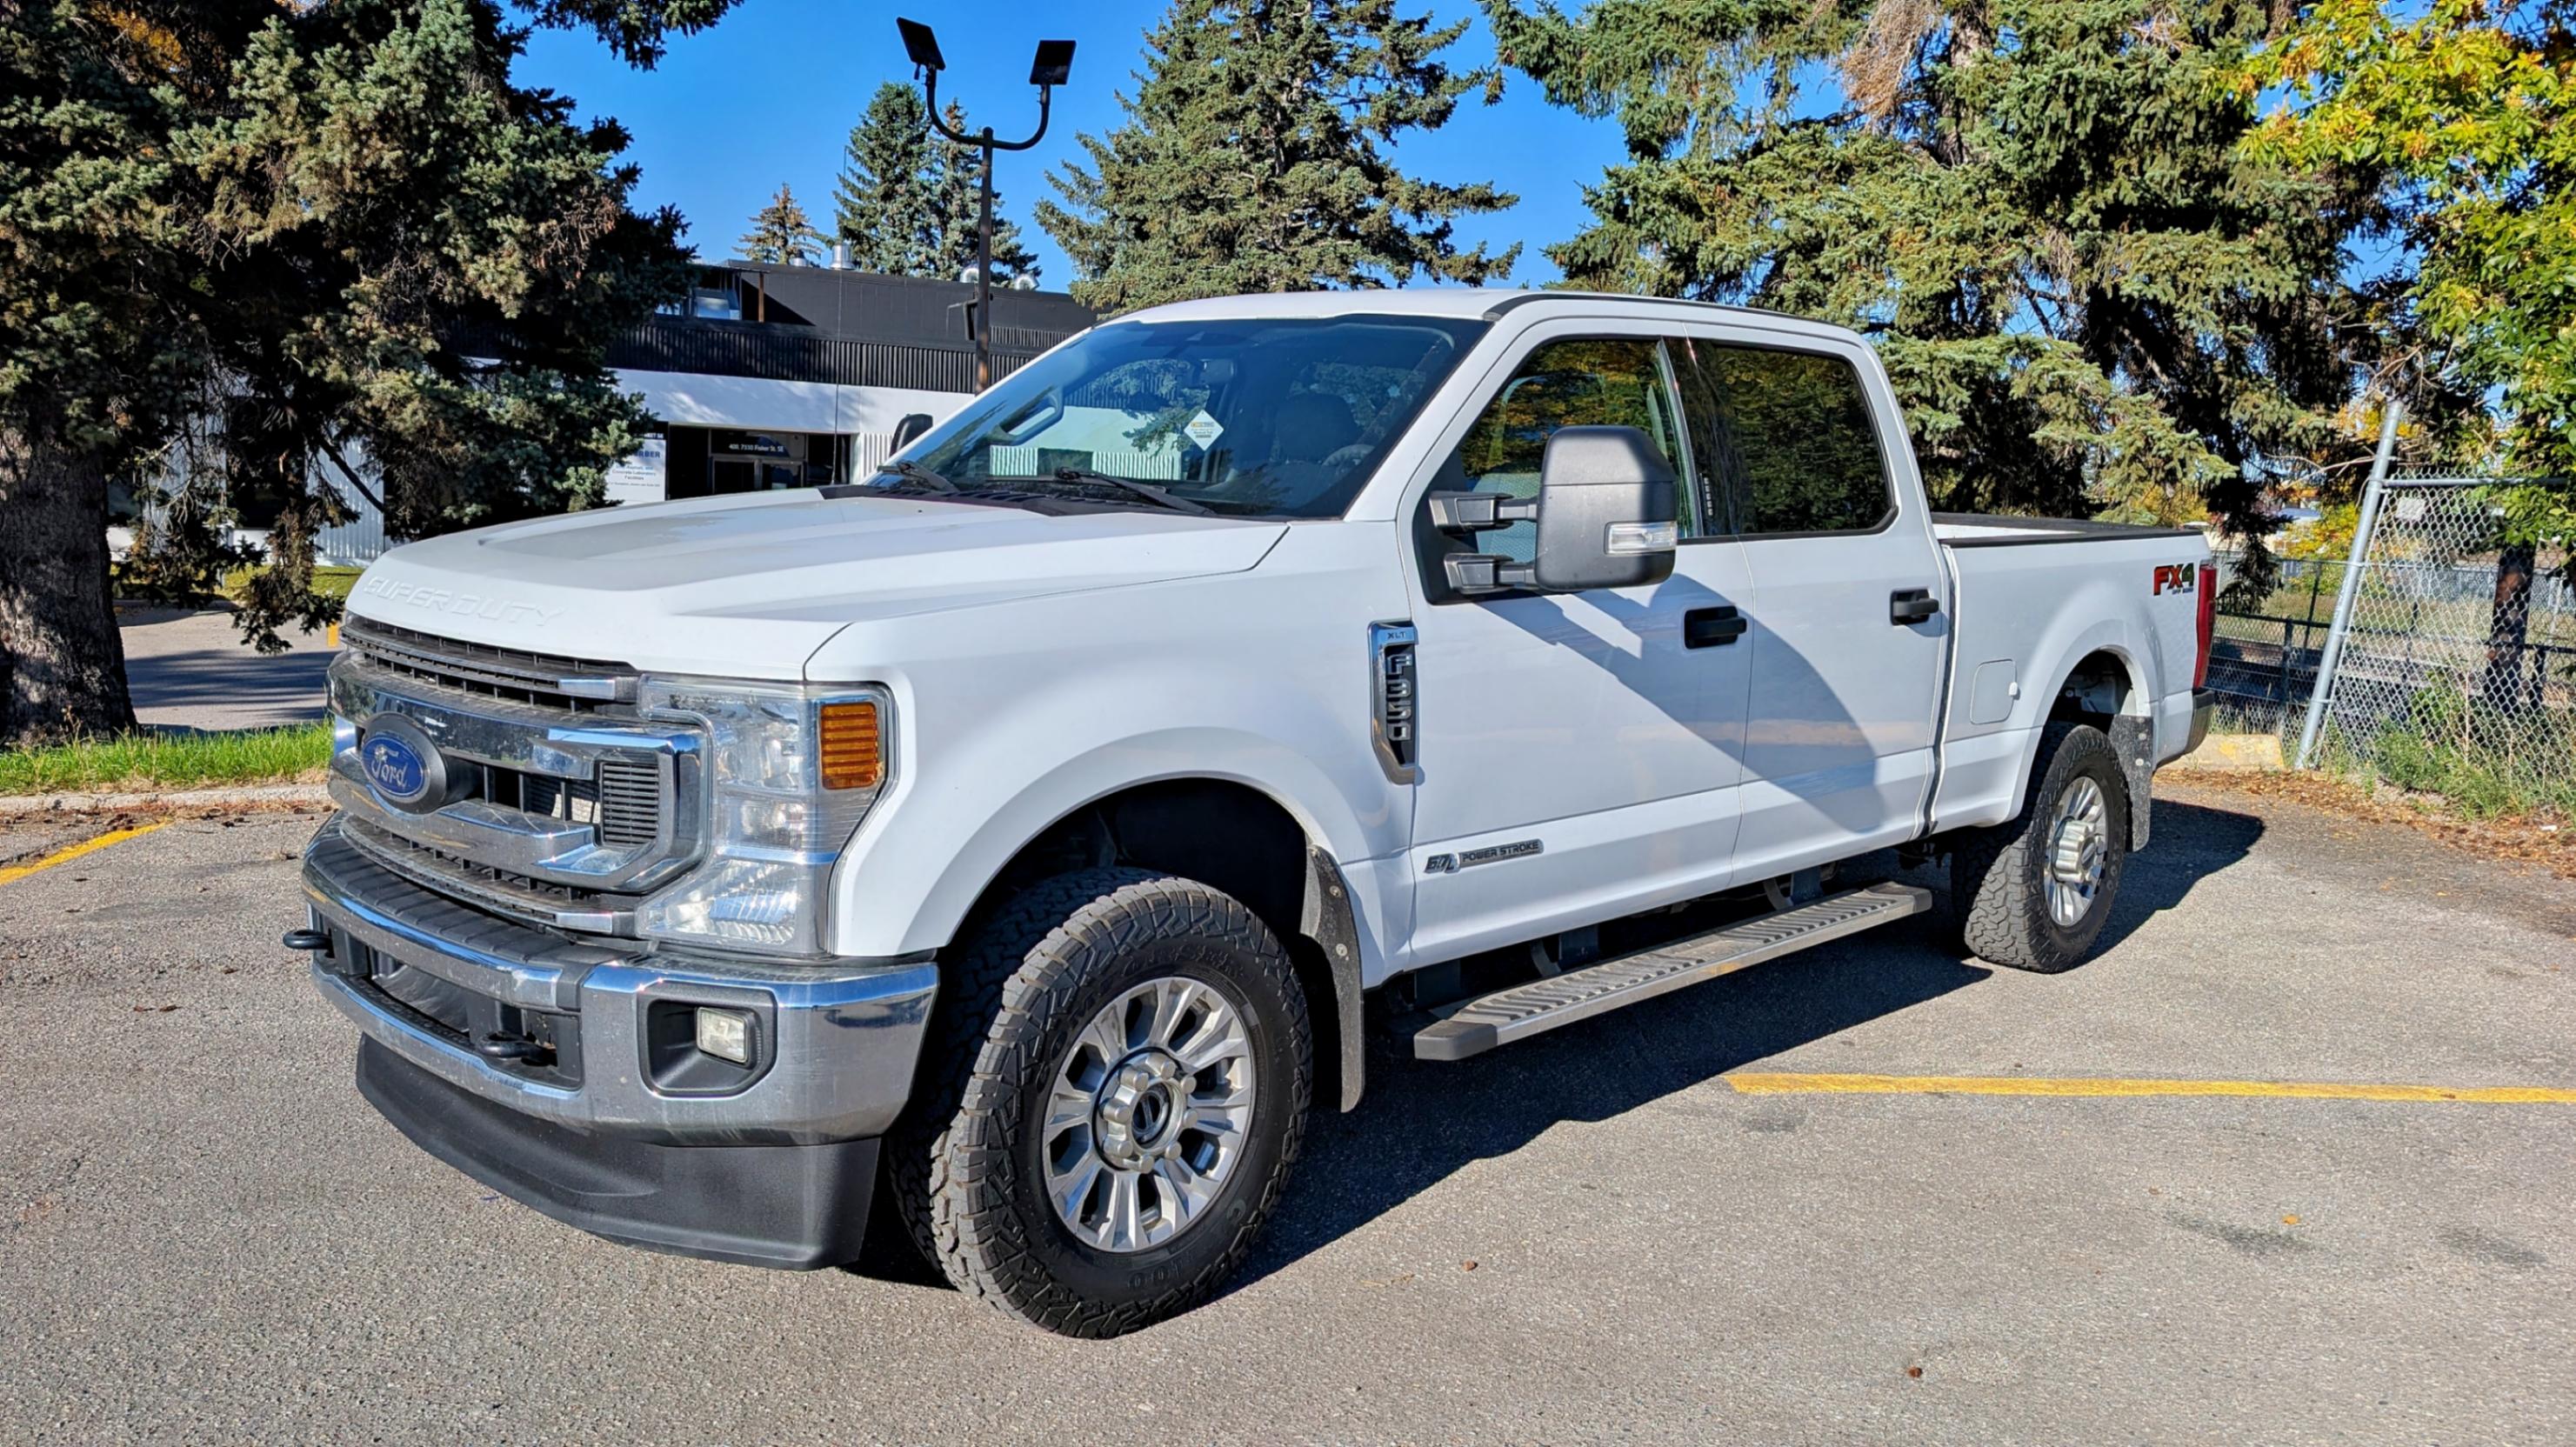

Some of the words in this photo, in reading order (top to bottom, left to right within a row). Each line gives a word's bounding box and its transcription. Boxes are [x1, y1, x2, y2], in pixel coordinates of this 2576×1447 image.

[364, 576, 450, 611] SUPER
[451, 594, 565, 627] DUTY
[2154, 563, 2194, 596] FX4
[1386, 653, 1412, 740] F350
[370, 744, 410, 788] Ford
[1462, 850, 1498, 863] POWER
[1499, 840, 1539, 856] STROKE
